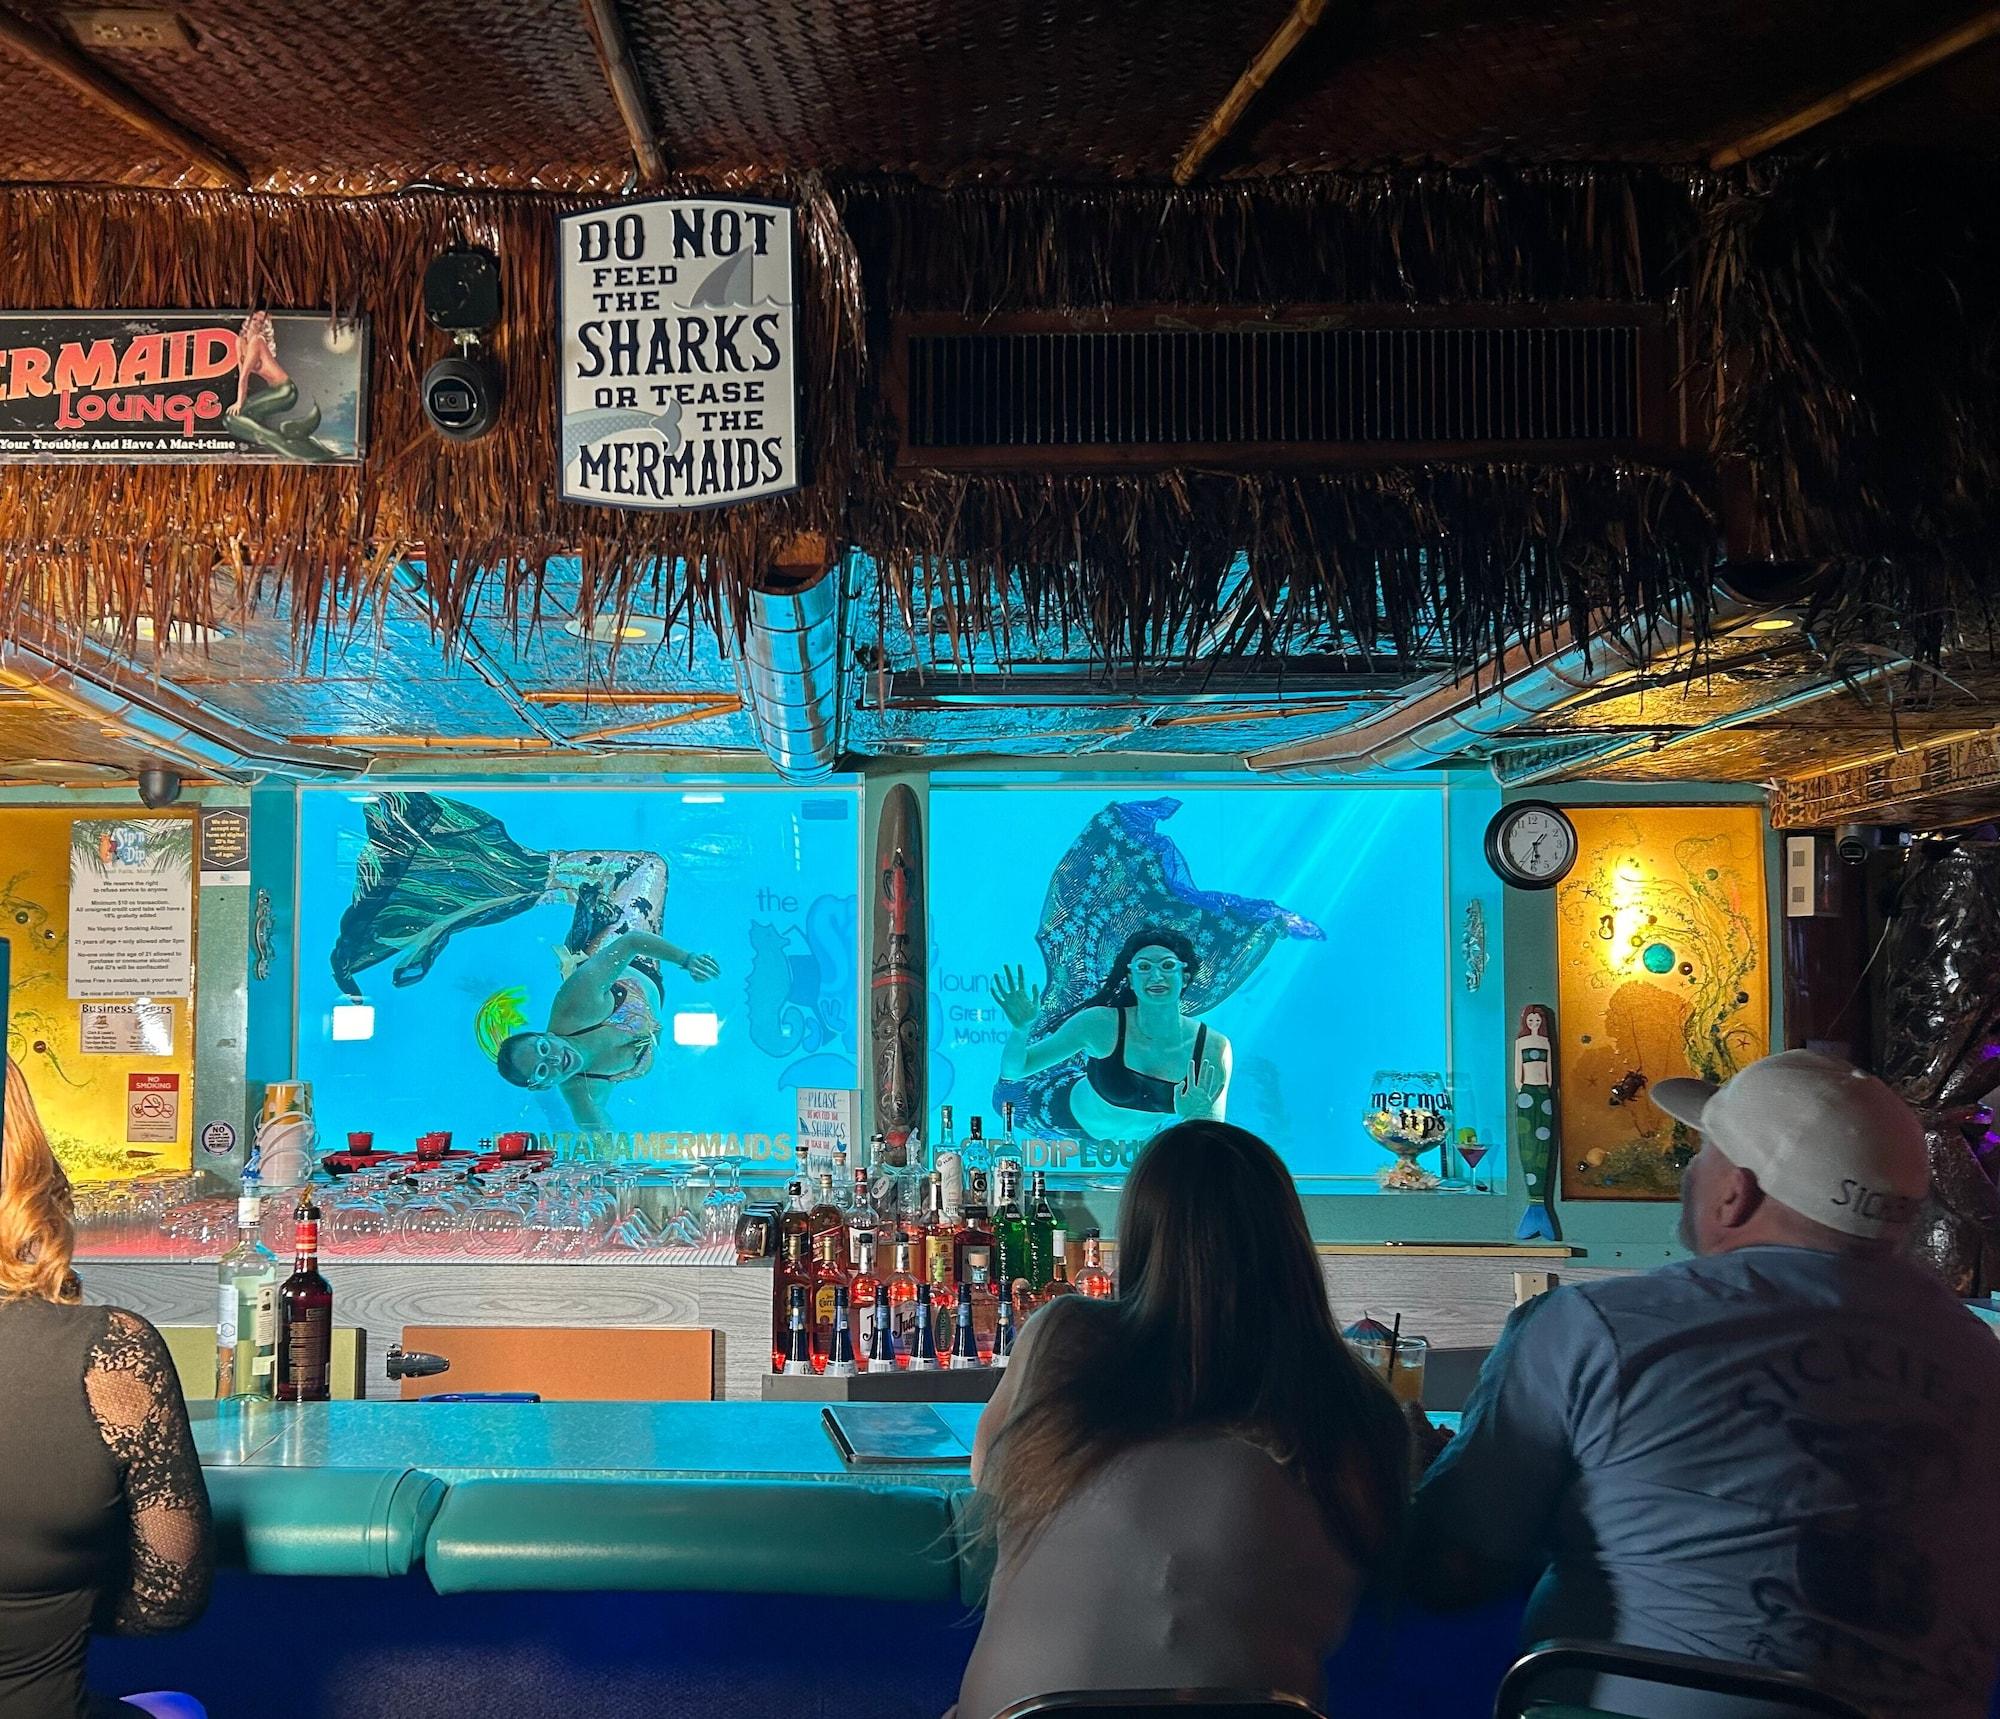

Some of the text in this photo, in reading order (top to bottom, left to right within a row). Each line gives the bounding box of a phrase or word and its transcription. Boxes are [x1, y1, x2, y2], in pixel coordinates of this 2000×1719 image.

[578, 208, 776, 263] DO NOT
[593, 265, 677, 288] FEED
[593, 290, 660, 313] THE
[577, 313, 781, 378] SHARKS
[0, 327, 240, 401] RMAID
[595, 381, 764, 409] OR TEASE
[54, 389, 223, 437] LOUNGE
[697, 410, 763, 432] THE
[0, 438, 236, 452] Your Troubles And Have A Mar-i-time
[578, 436, 783, 500] MERMAIDS
[755, 887, 799, 913] the
[939, 967, 1010, 993] loun
[82, 1004, 133, 1014] Business
[949, 1005, 998, 1021] Great
[954, 1028, 1009, 1044] Monta
[808, 1091, 838, 1109] PLEASE
[1371, 1091, 1453, 1113] merma
[811, 1121, 846, 1139] SHARKS
[1399, 1109, 1446, 1138] tips
[479, 1131, 791, 1161] #ONTANAMERMAIDS
